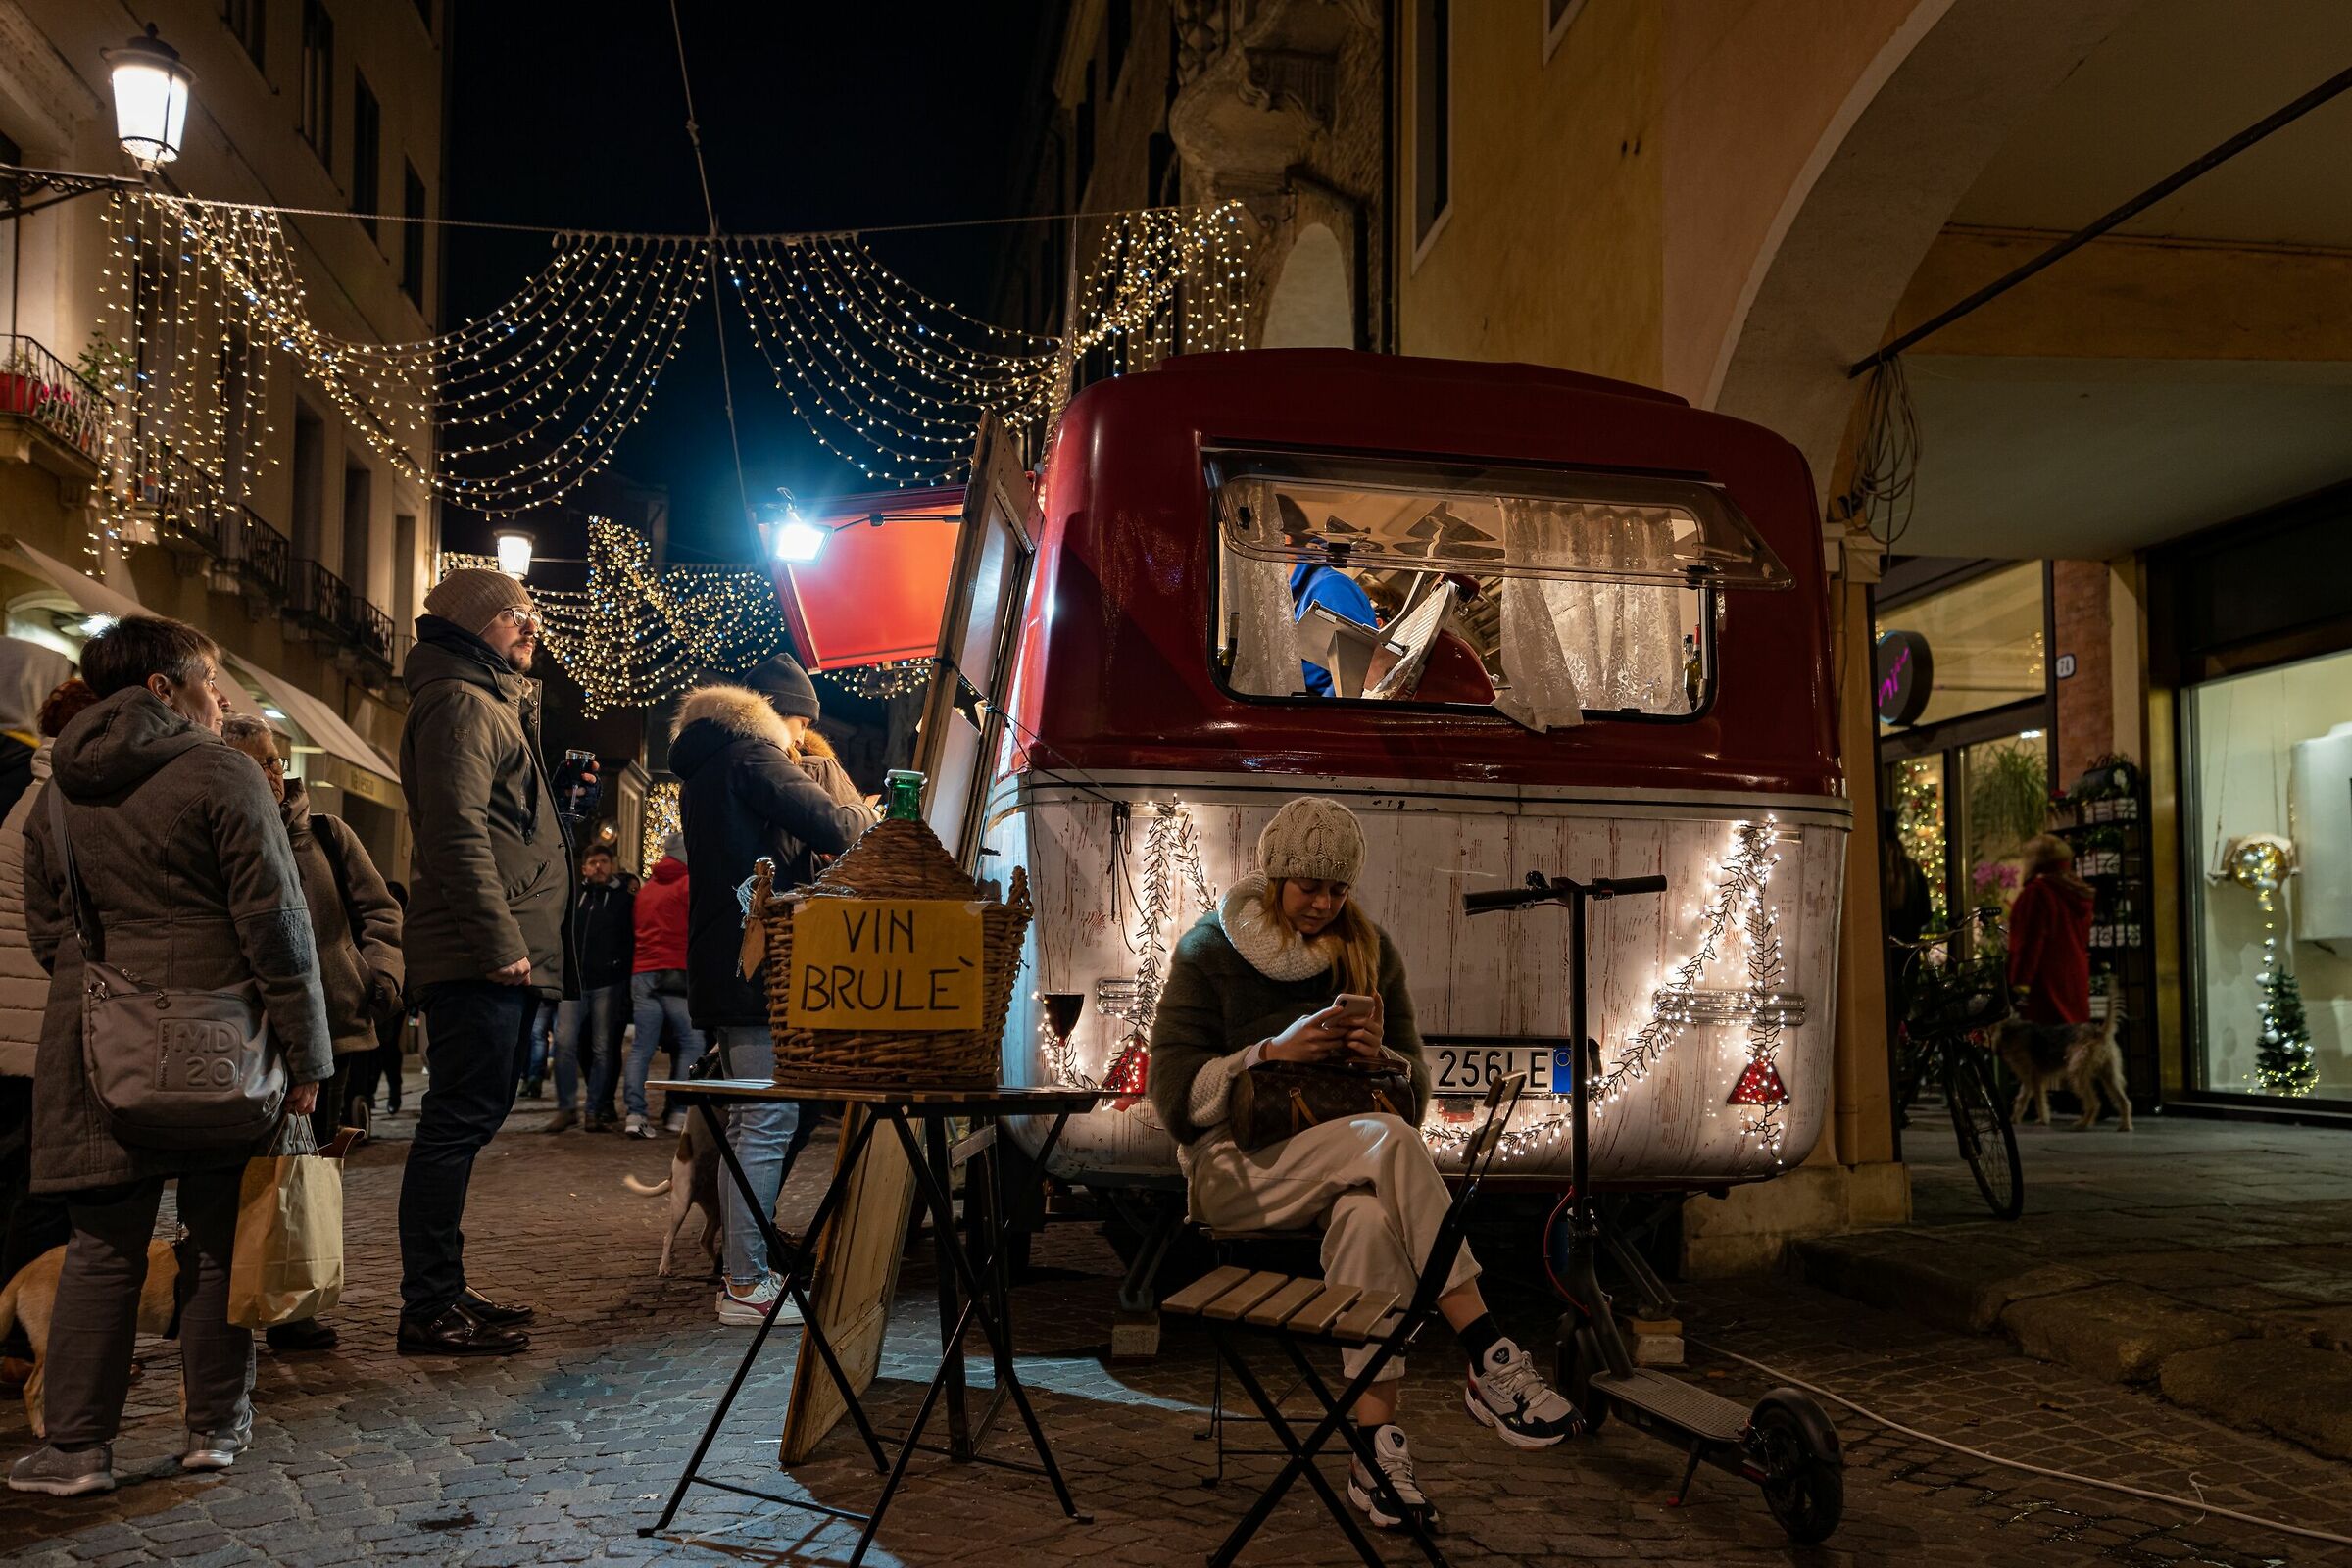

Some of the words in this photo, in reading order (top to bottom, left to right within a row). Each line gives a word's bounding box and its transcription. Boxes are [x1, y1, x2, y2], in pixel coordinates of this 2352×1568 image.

[843, 908, 914, 954] VIN
[174, 1023, 237, 1054] MD
[186, 1056, 236, 1087] 20
